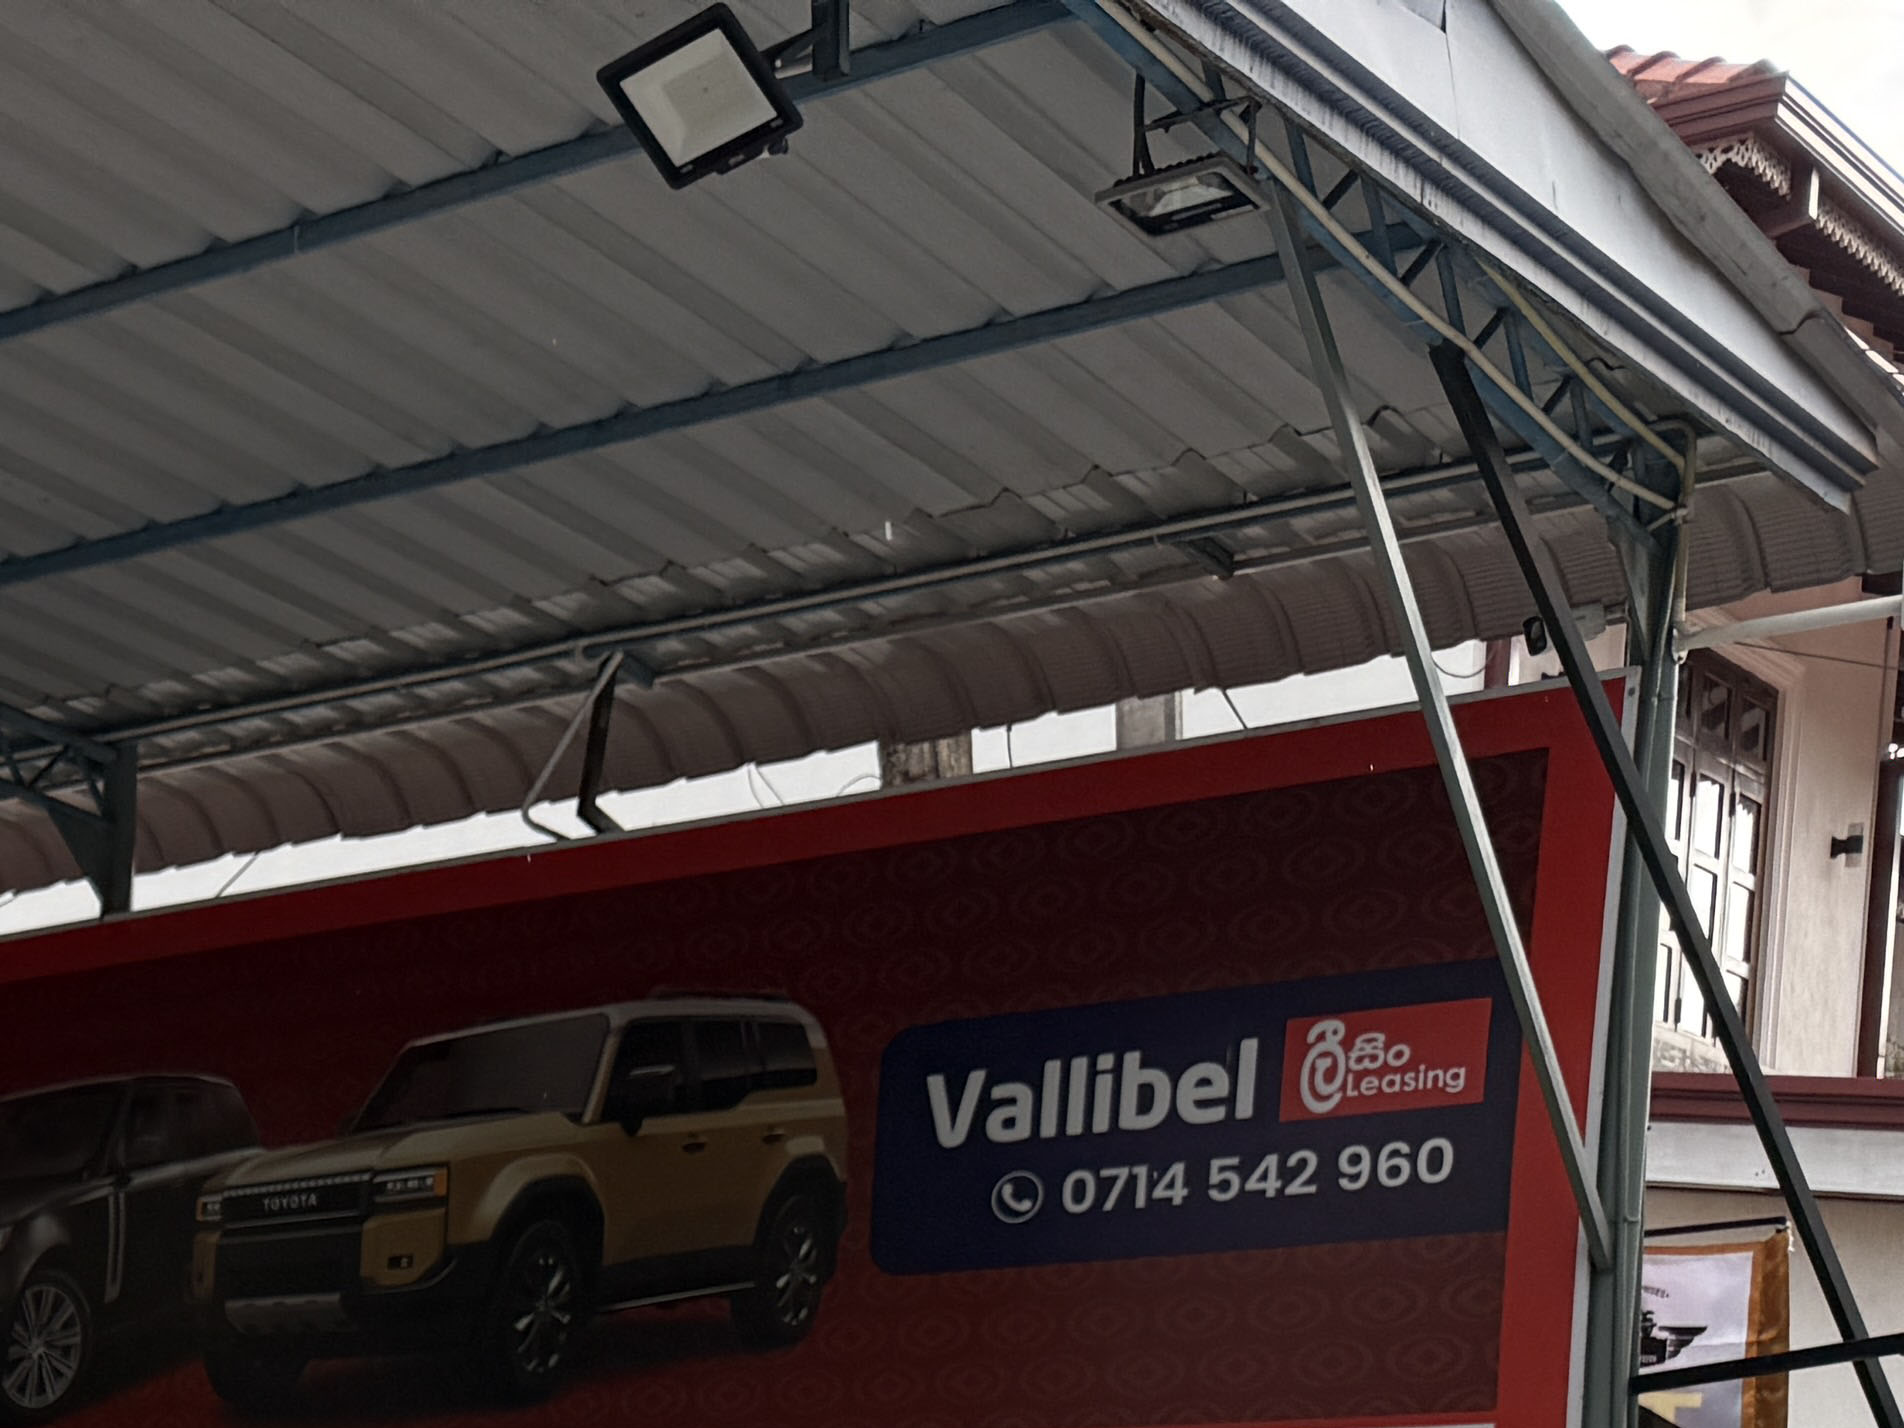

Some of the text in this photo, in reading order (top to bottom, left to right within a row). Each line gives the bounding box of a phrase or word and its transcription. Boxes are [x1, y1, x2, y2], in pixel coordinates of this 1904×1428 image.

[925, 1036, 1260, 1150] Vallibel
[1345, 1062, 1467, 1099] Leasing
[1060, 1136, 1455, 1215] 0714 542 960
